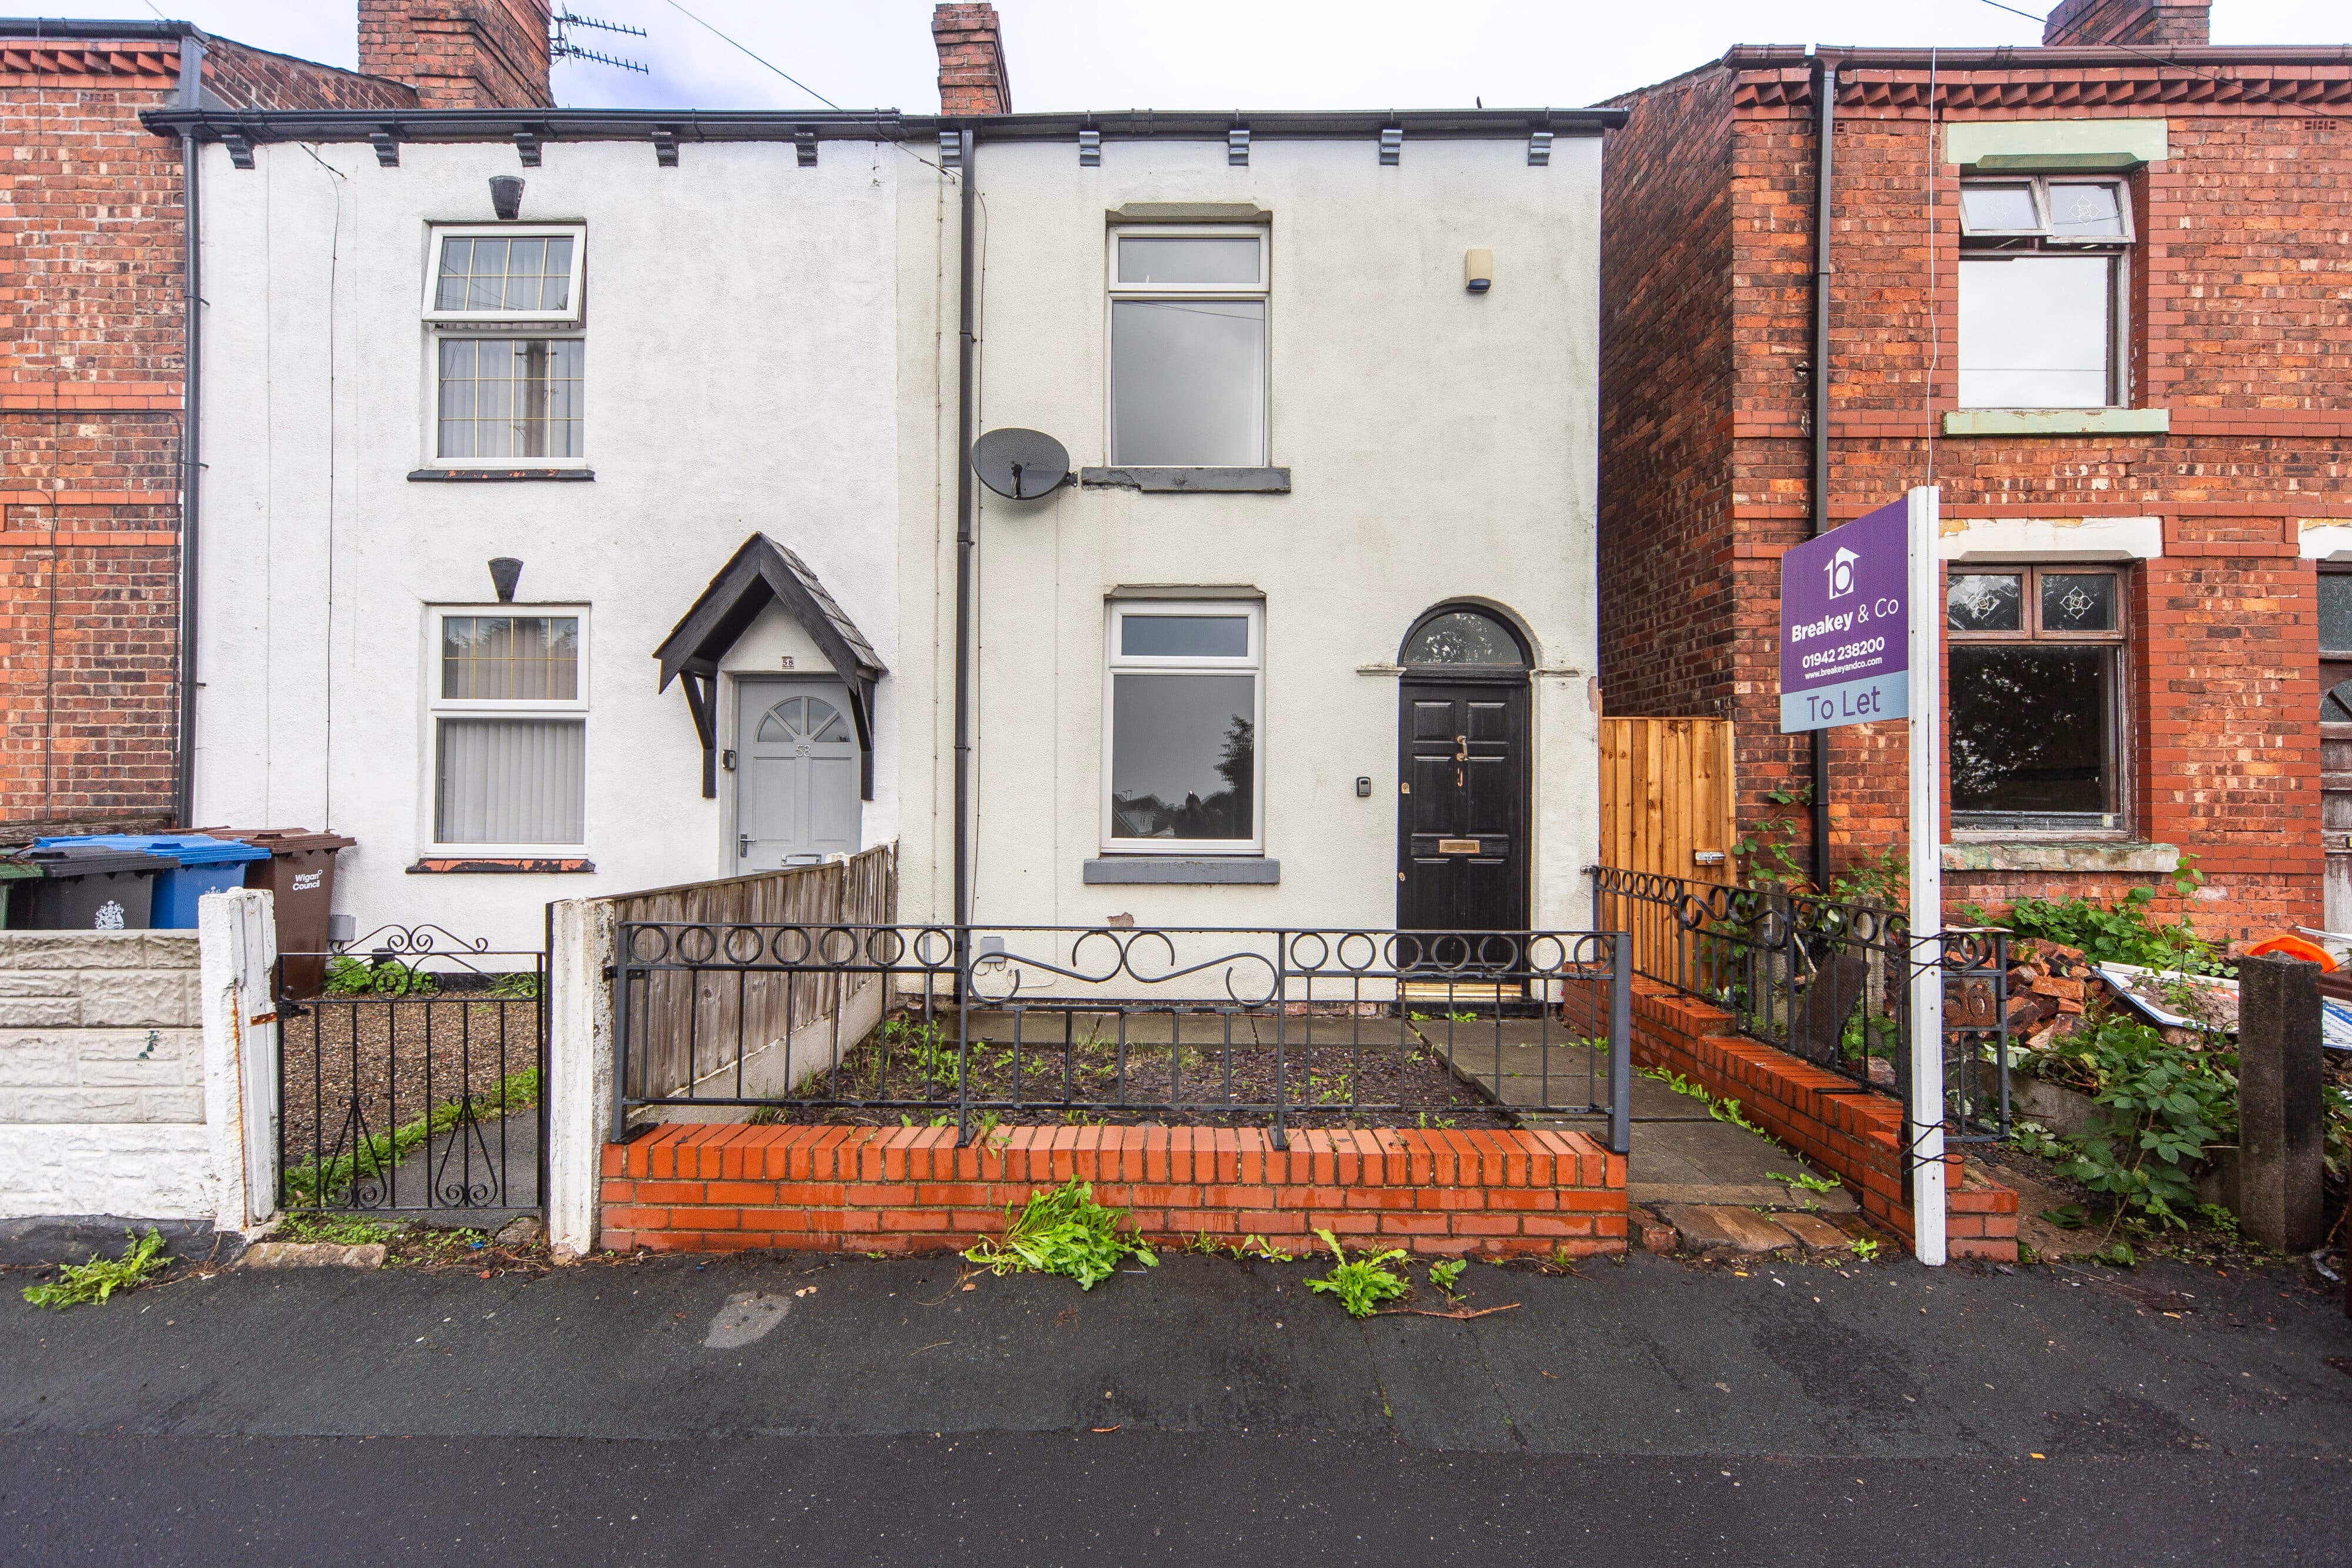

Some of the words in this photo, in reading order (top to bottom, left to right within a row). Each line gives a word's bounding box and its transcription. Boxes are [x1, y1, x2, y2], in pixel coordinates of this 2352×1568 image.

[1792, 611, 1853, 643] Breakey
[1857, 604, 1869, 623] &
[1875, 598, 1899, 618] Co
[1802, 649, 1835, 668] 01942
[1838, 636, 1885, 661] 238200
[1805, 657, 1882, 680] www.breakeyandco.com
[1806, 695, 1834, 721] To
[1843, 686, 1880, 717] Let
[796, 744, 811, 757] 58
[292, 880, 320, 891] Council
[295, 873, 319, 882] Wigan
[1942, 980, 1987, 1018] 56
